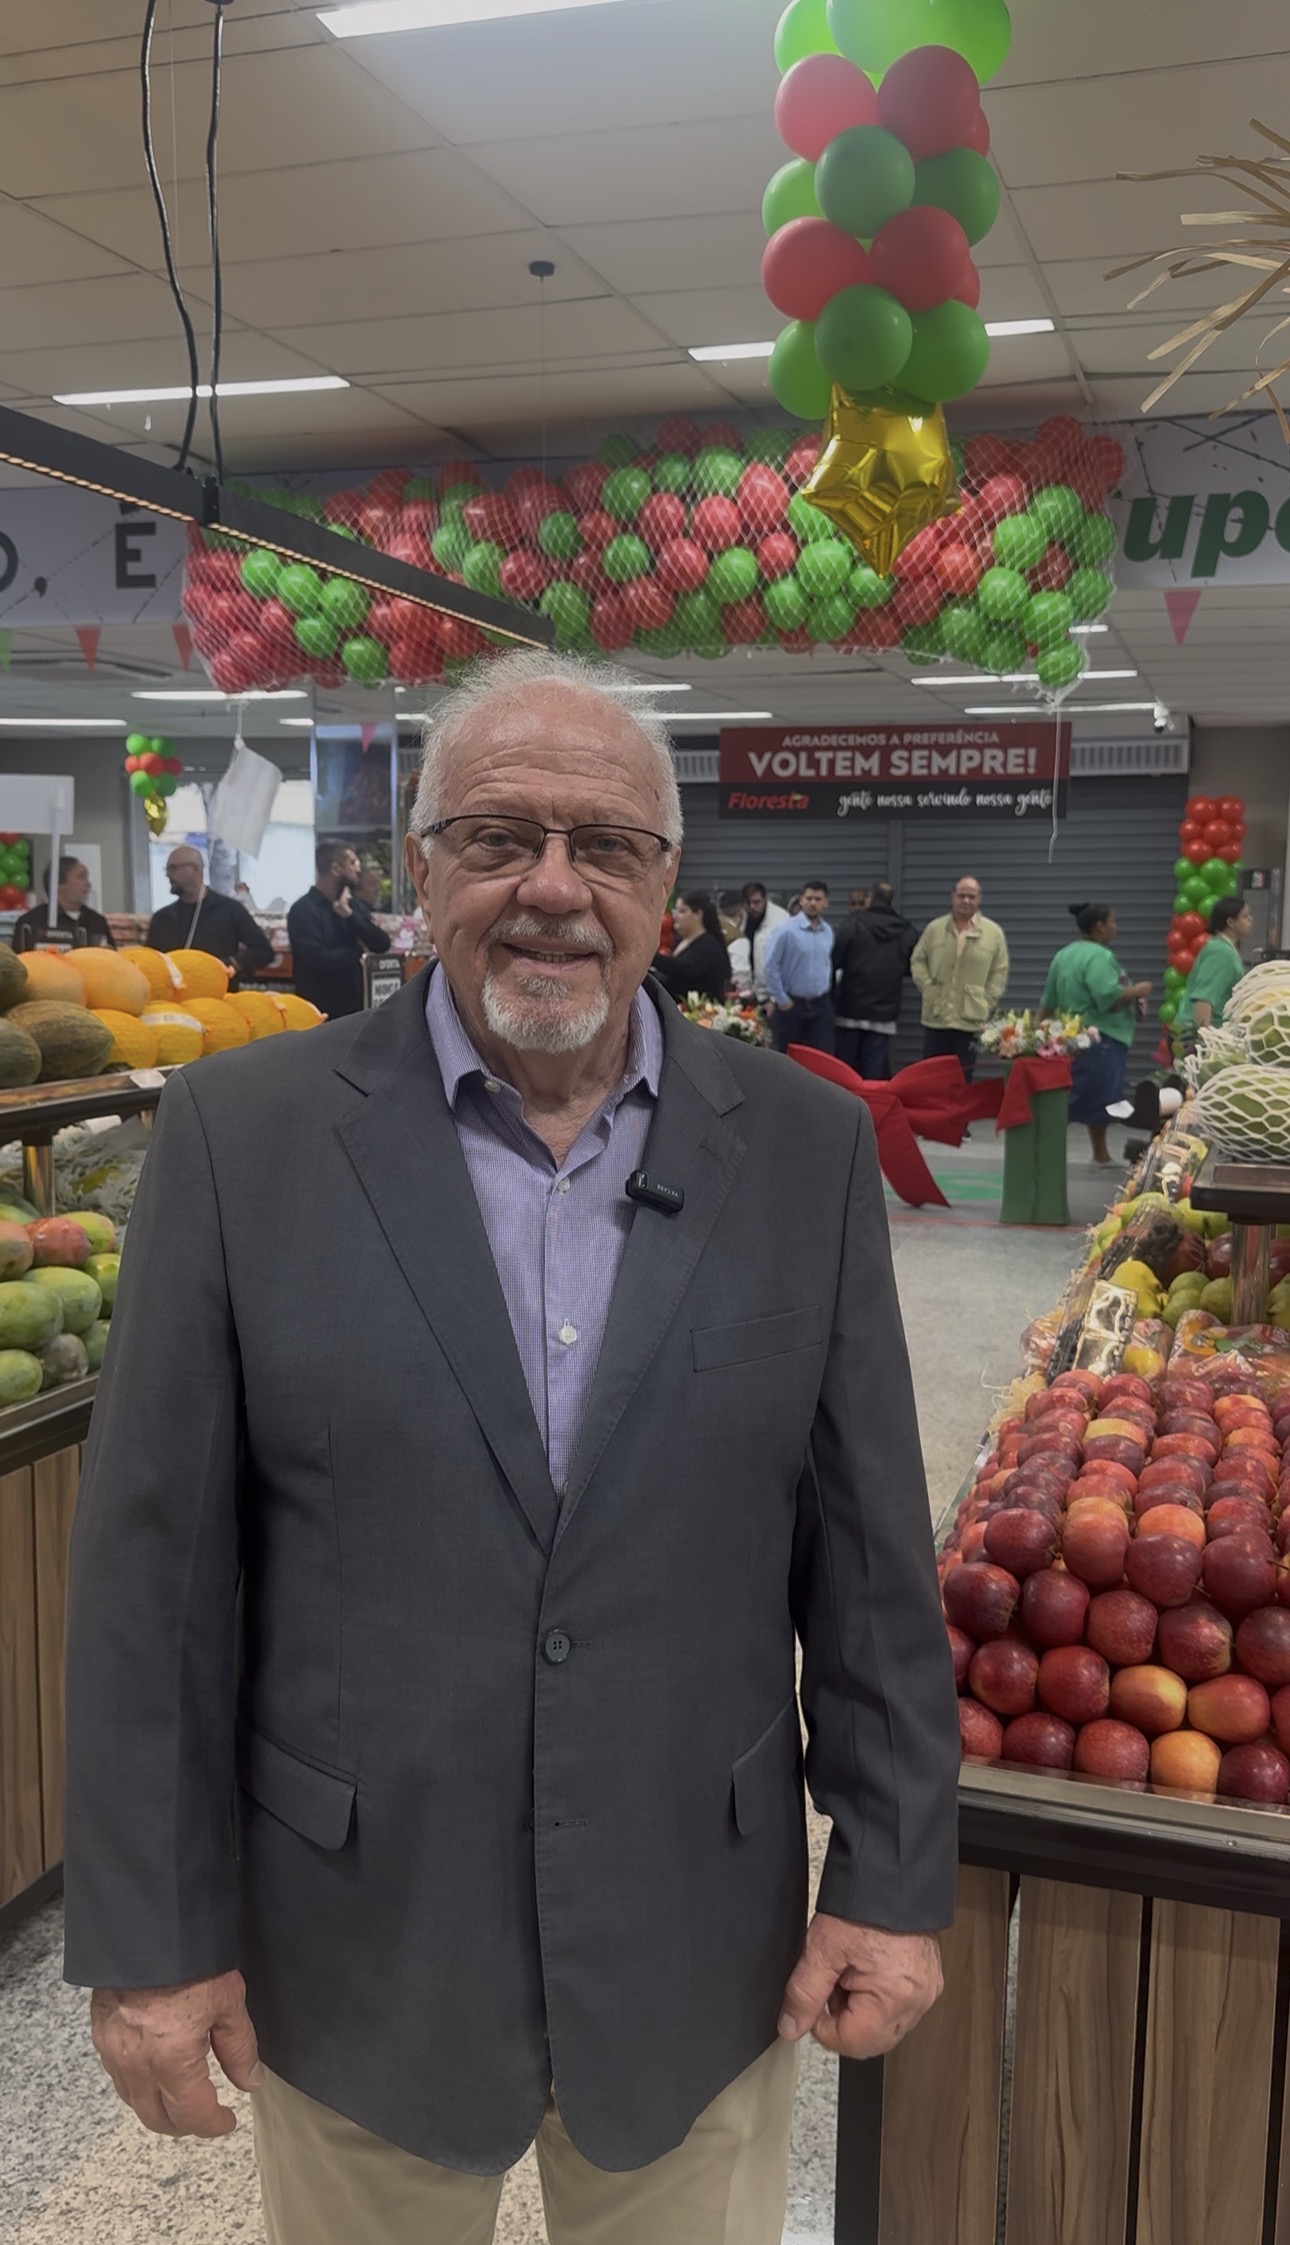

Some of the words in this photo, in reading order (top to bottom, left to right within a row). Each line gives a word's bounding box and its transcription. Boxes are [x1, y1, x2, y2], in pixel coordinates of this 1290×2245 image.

[781, 733, 886, 747] AGRADECEMOS
[889, 734, 900, 745] A
[903, 729, 999, 745] PREFERÊNCIA
[747, 750, 880, 778] VOLTEM
[889, 747, 1037, 776] SEMPRE!
[727, 791, 810, 810] Floresta
[837, 789, 874, 817] gente
[877, 793, 912, 807] nossa
[916, 786, 972, 807] servindo
[976, 792, 1013, 807] nossa
[1014, 788, 1053, 817] gente
